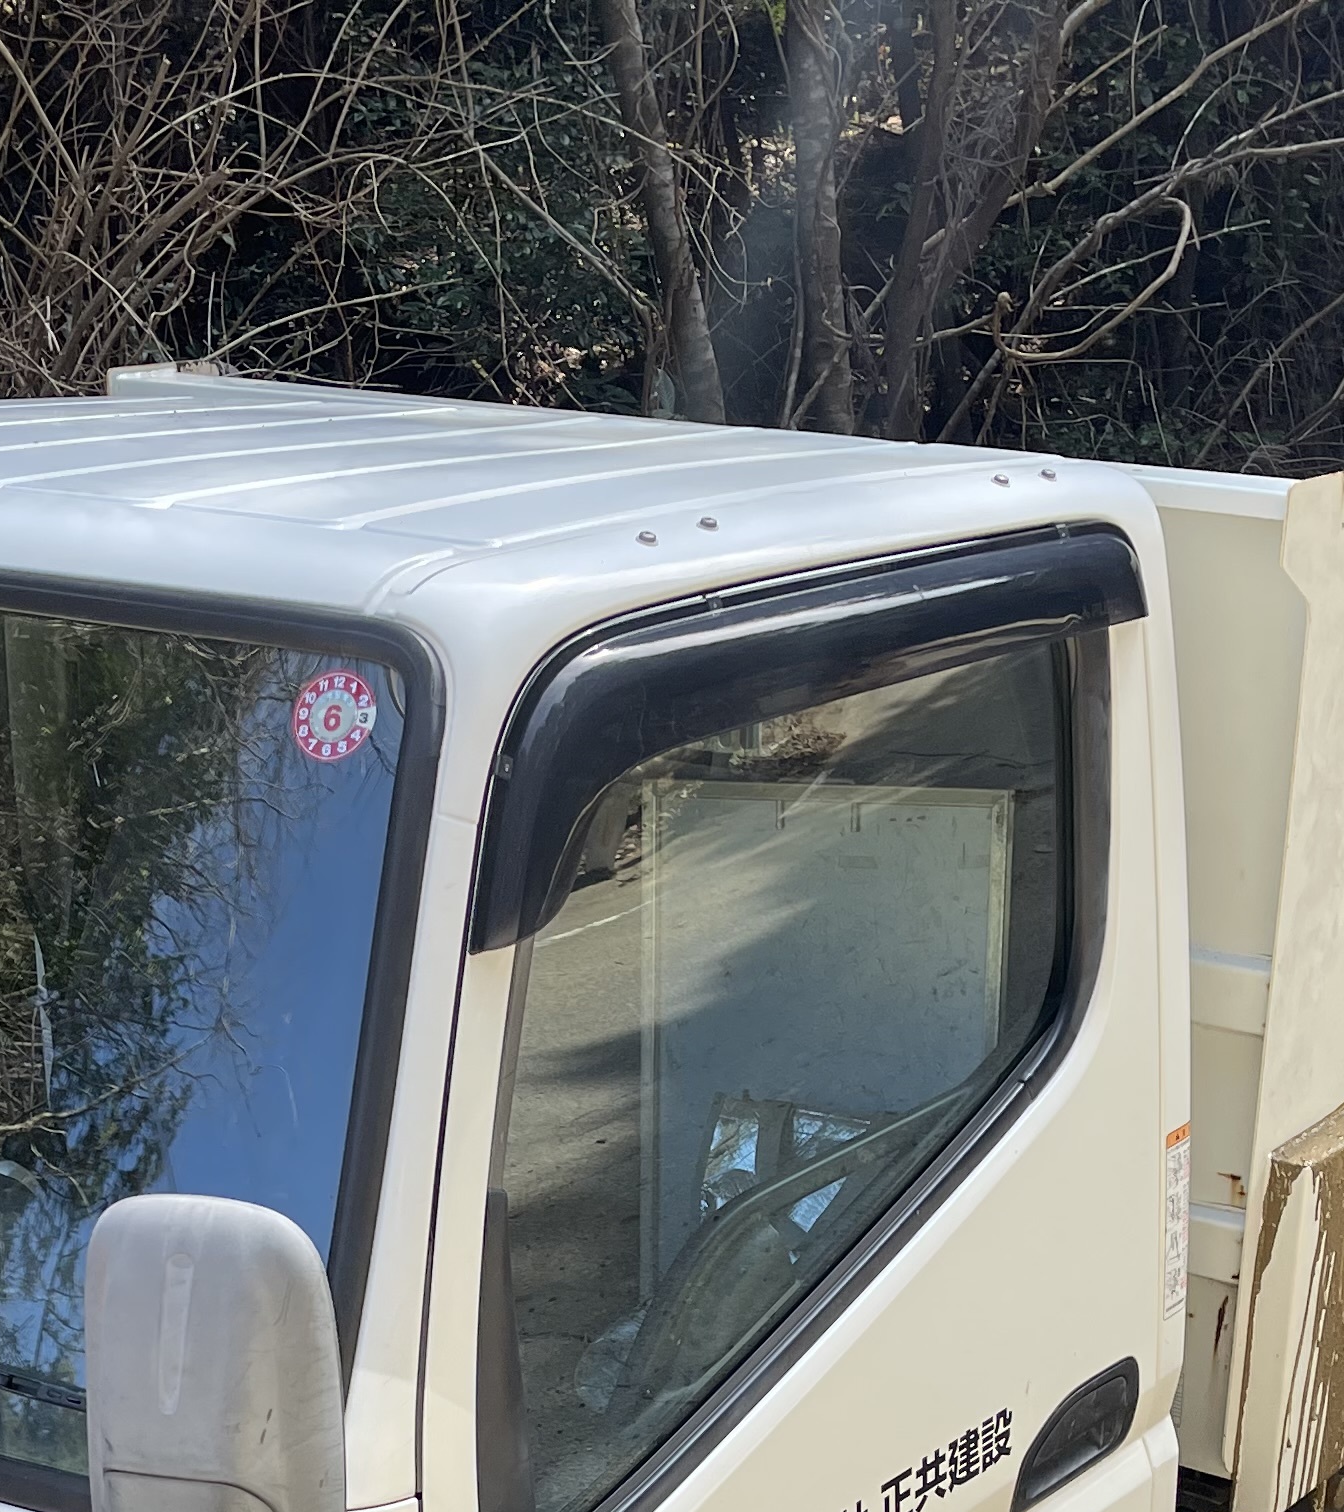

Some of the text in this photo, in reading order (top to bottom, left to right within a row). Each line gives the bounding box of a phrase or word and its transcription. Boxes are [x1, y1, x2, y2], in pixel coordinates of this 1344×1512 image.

[299, 676, 369, 756] 12 1 2 3 4 5 6 7 8 9 10 11
[323, 704, 343, 732] 6
